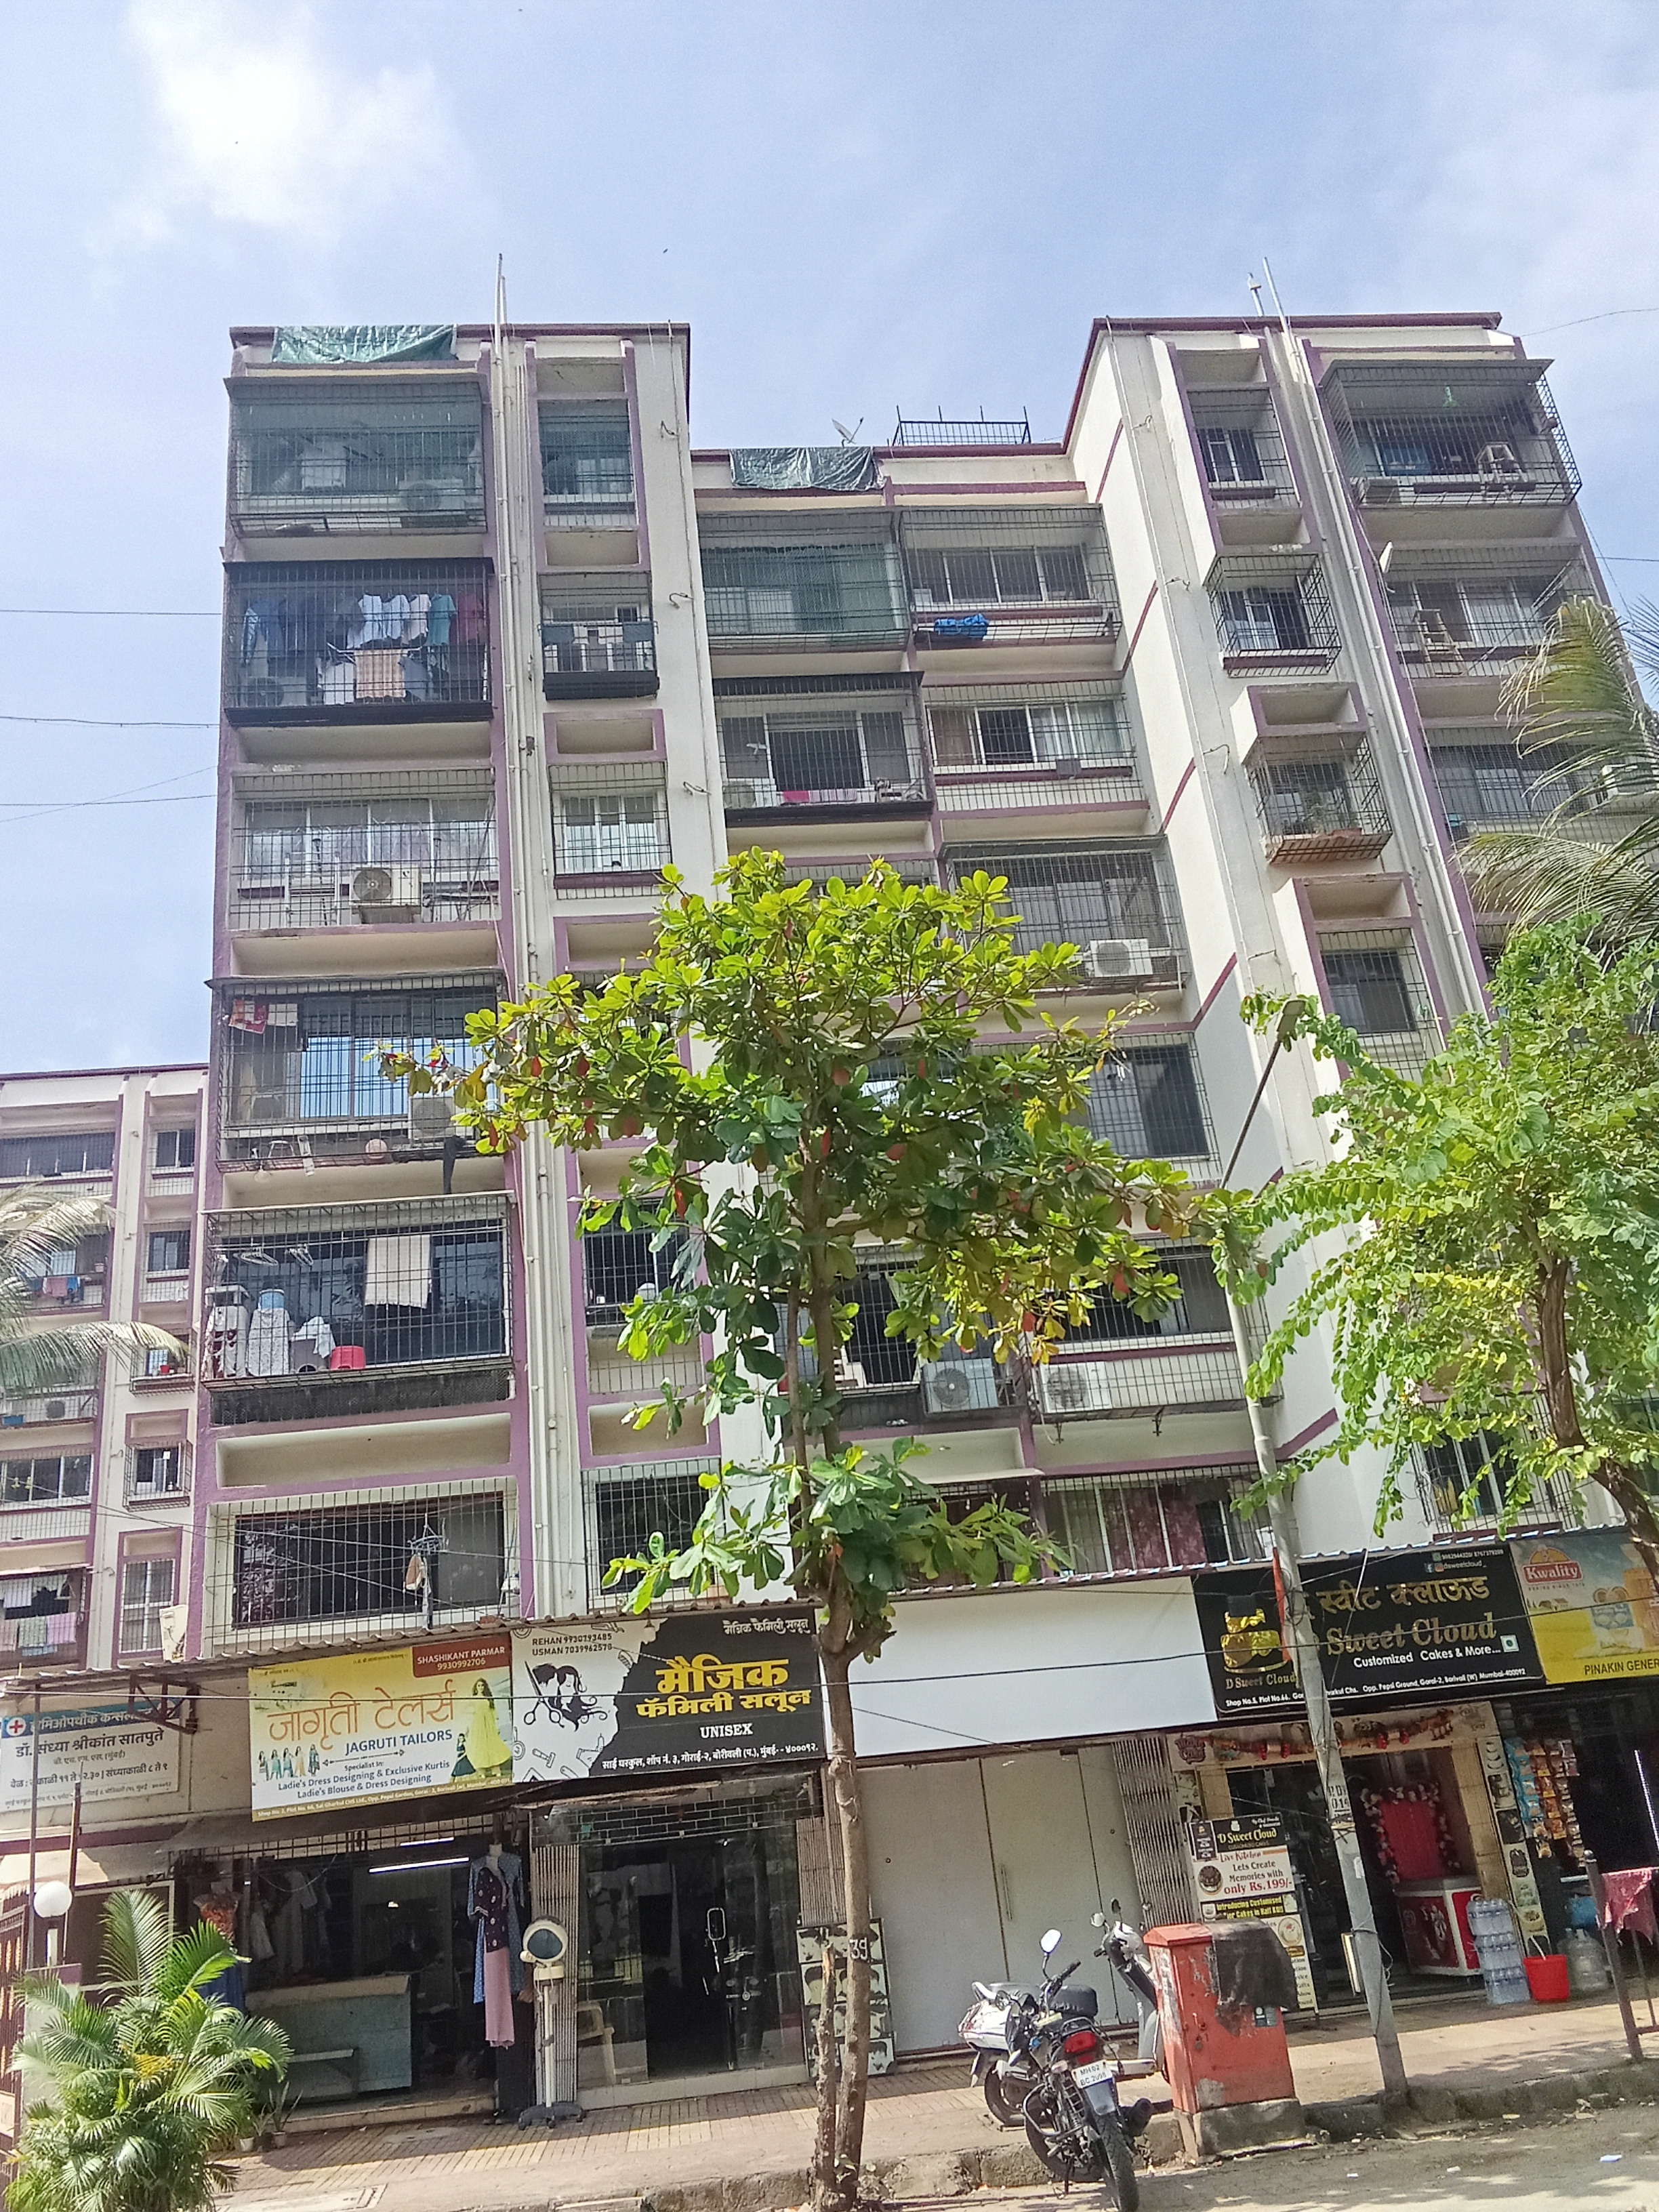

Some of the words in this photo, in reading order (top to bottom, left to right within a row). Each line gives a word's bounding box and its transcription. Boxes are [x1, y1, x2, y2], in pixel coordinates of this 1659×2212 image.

[1525, 1565, 1578, 1580] Kwality
[1315, 1580, 1382, 1614] स्वीट
[1386, 1576, 1491, 1606] क्लाऊड
[532, 1637, 562, 1646] REHAN
[1326, 1622, 1406, 1656] Sweet
[1411, 1611, 1497, 1647] Cloud
[417, 1651, 469, 1665] SHASHIKANT
[470, 1646, 506, 1657] PARMAR
[532, 1646, 563, 1656] USMAN
[1353, 1652, 1414, 1668] Customized
[1420, 1646, 1453, 1660] Cakes
[1454, 1647, 1463, 1658] &
[436, 1657, 487, 1671] 9930992706
[1584, 1661, 1624, 1676] PINAKIN
[1225, 1679, 1234, 1689] D
[1235, 1676, 1263, 1689] Sweet
[1265, 1671, 1297, 1685] Cloud
[1362, 1685, 1378, 1693] Opp.
[739, 1689, 813, 1713] सलून
[1226, 1699, 1242, 1707] Shop
[1258, 1694, 1271, 1704] Plot
[267, 1692, 361, 1750] जागृती
[371, 1679, 457, 1729] टेलर्स
[699, 1722, 754, 1739] UNISEX
[16, 1742, 33, 1757] डॉ.
[37, 1740, 70, 1755] संध्या
[72, 1733, 117, 1750] श्रीकांत
[119, 1726, 164, 1746] सातपुते
[344, 1736, 397, 1756] JAGRUTI
[400, 1729, 453, 1747] TAILORS
[344, 1761, 374, 1772] Specialist
[601, 1757, 618, 1771] साई
[646, 1753, 662, 1766] शॉप
[278, 1779, 306, 1790] Ladie's
[308, 1777, 331, 1787] Dress
[333, 1770, 375, 1783] Designing
[376, 1768, 384, 1778] &
[385, 1763, 424, 1776] Exclusive
[424, 1760, 451, 1771] Kurtis
[297, 1786, 326, 1799] Ladie's
[327, 1783, 355, 1795] Blouse
[356, 1782, 364, 1790] &
[365, 1778, 389, 1789] Dress
[390, 1773, 432, 1786] Designing
[1227, 1831, 1253, 1844] Sweet
[1253, 1827, 1277, 1841] Cloud
[1220, 1852, 1233, 1862] Live
[1235, 1851, 1262, 1861] Kitchen
[1233, 1863, 1250, 1872] Lets
[1251, 1860, 1276, 1870] Create
[1229, 1871, 1266, 1883] Memories
[1267, 1869, 1284, 1878] with
[1224, 1883, 1247, 1896] only
[1249, 1878, 1292, 1891] Rs.199/-
[849, 1937, 868, 1960] 39
